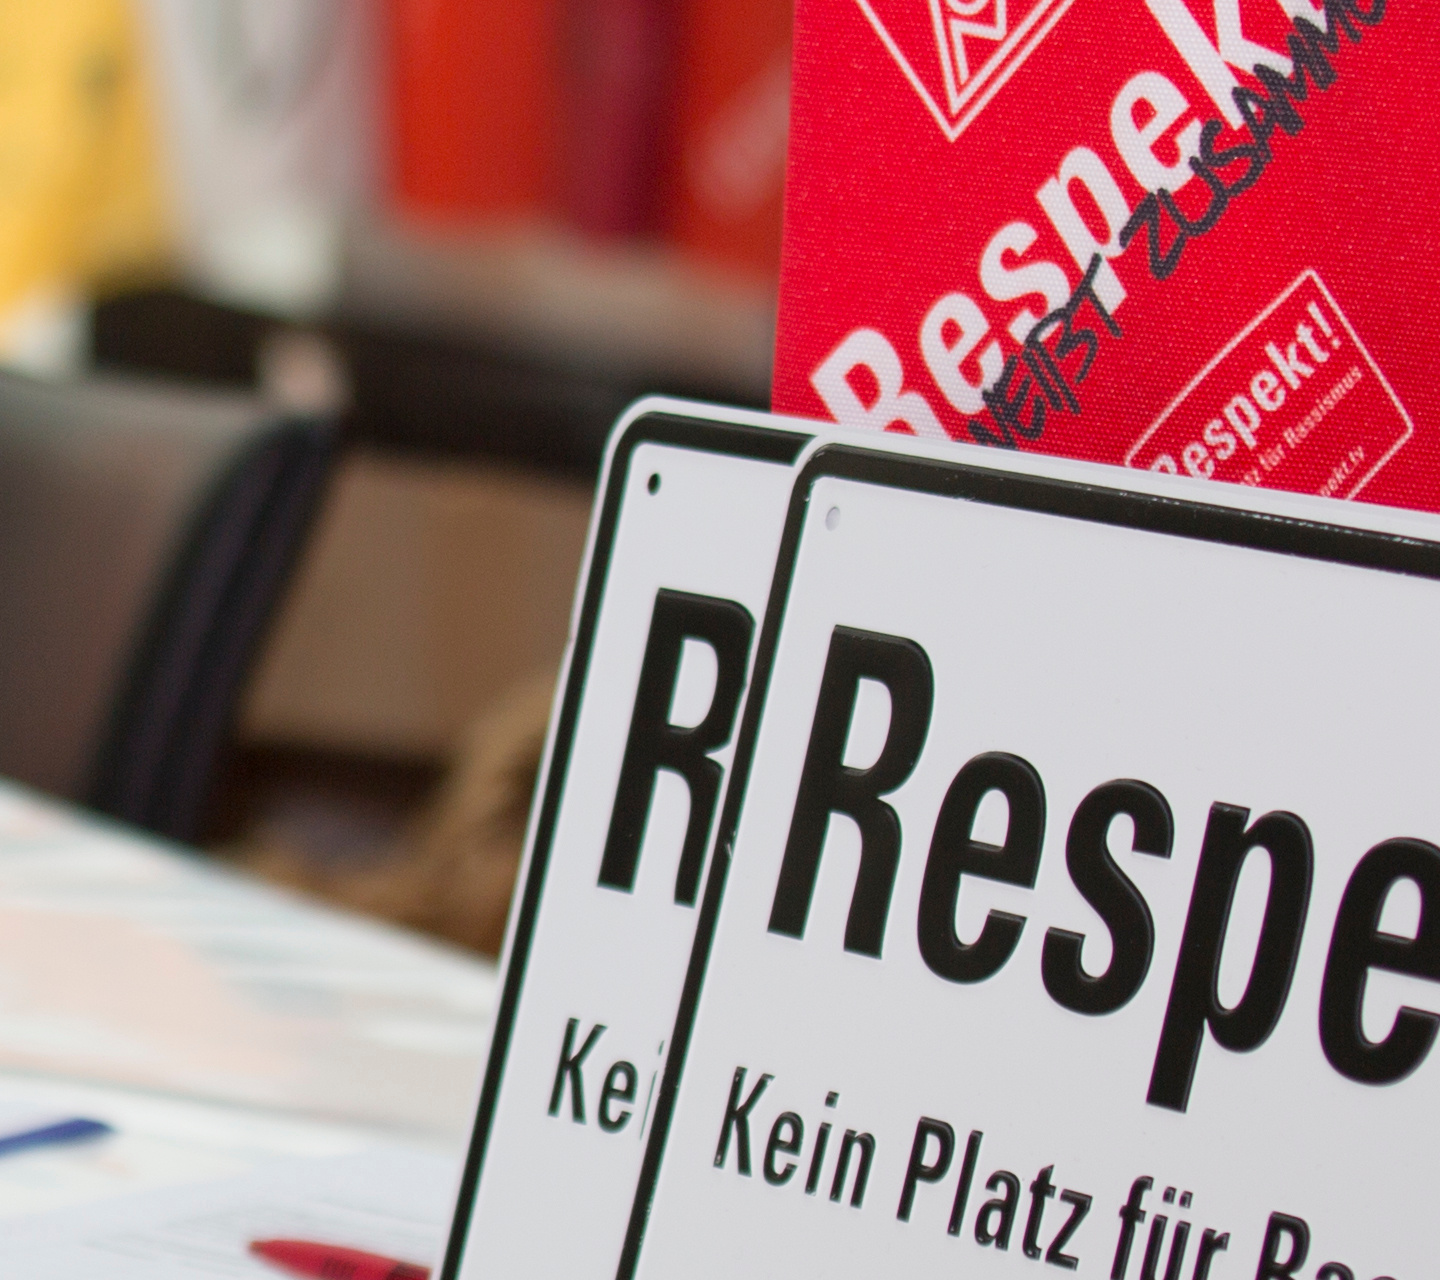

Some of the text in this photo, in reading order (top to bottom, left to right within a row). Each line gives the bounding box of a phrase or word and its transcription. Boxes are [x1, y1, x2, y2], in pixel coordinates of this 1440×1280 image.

[1282, 365, 1364, 449] Rassismus
[547, 1017, 666, 1141] Ke
[712, 1066, 877, 1209] Kein
[895, 1115, 1093, 1271] Platz
